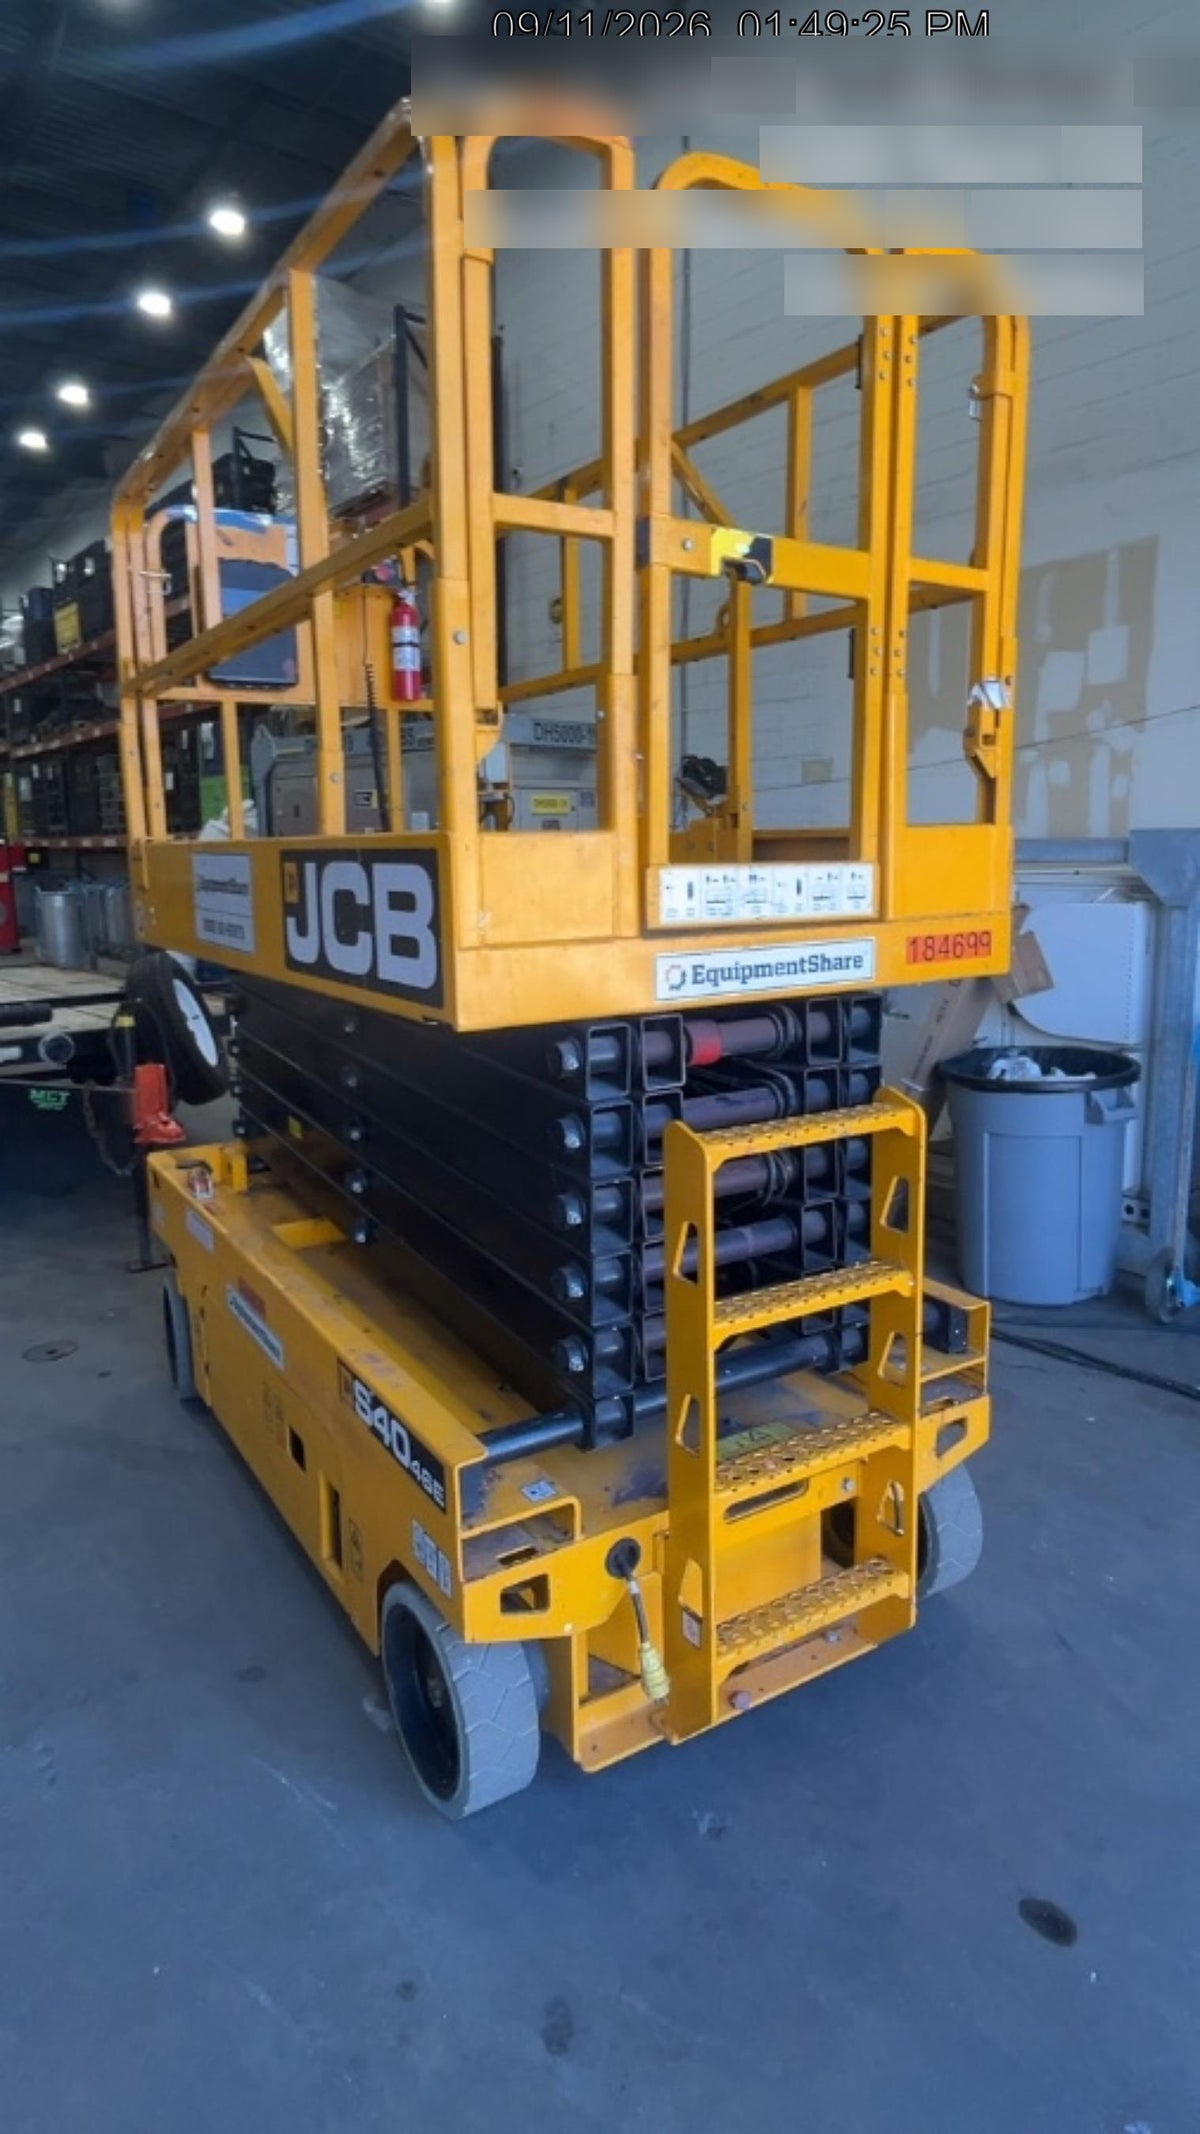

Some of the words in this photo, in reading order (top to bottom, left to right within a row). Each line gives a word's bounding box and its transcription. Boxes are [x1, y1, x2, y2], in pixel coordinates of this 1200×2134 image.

[286, 860, 437, 989] JCB
[910, 931, 991, 963] 184699
[691, 953, 864, 987] EquipmentShare
